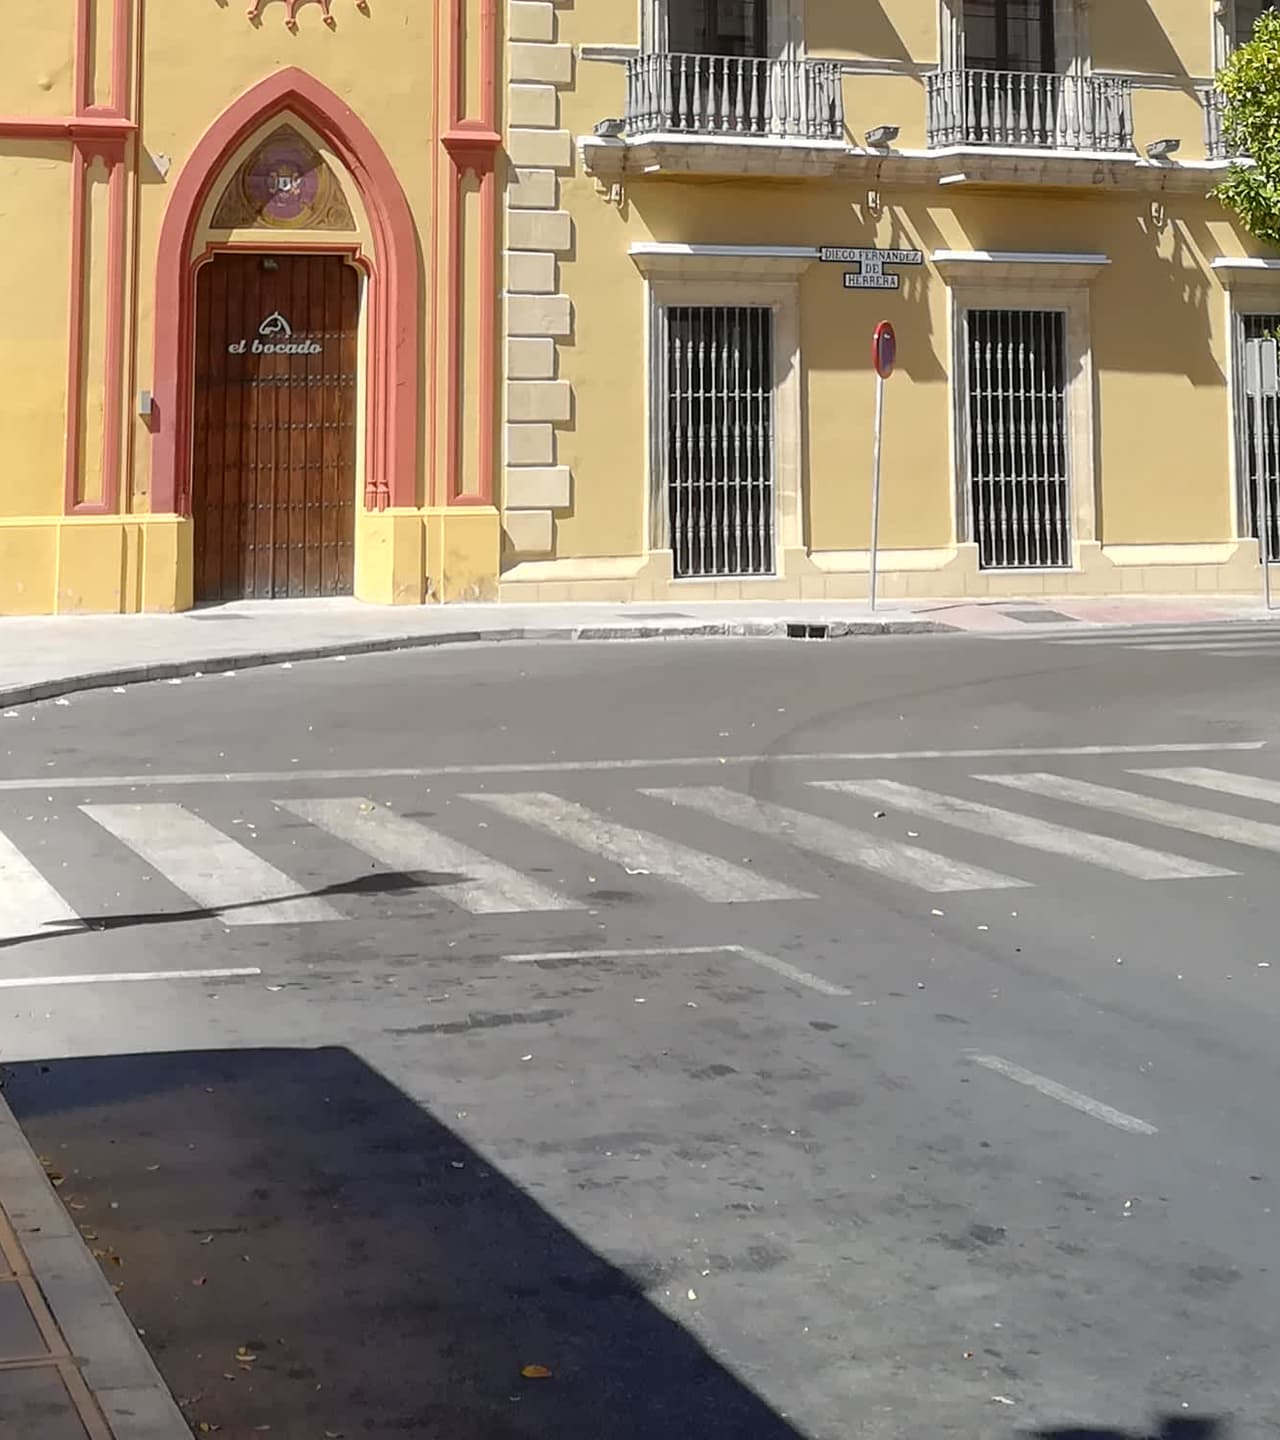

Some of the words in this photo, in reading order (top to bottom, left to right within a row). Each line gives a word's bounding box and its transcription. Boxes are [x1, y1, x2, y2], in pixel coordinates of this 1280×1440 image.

[825, 249, 856, 260] DIEGO
[858, 250, 920, 262] FERNANDEZ
[865, 263, 880, 274] DE
[848, 276, 896, 287] HERRERA
[228, 339, 247, 354] el
[251, 339, 323, 354] bocado
